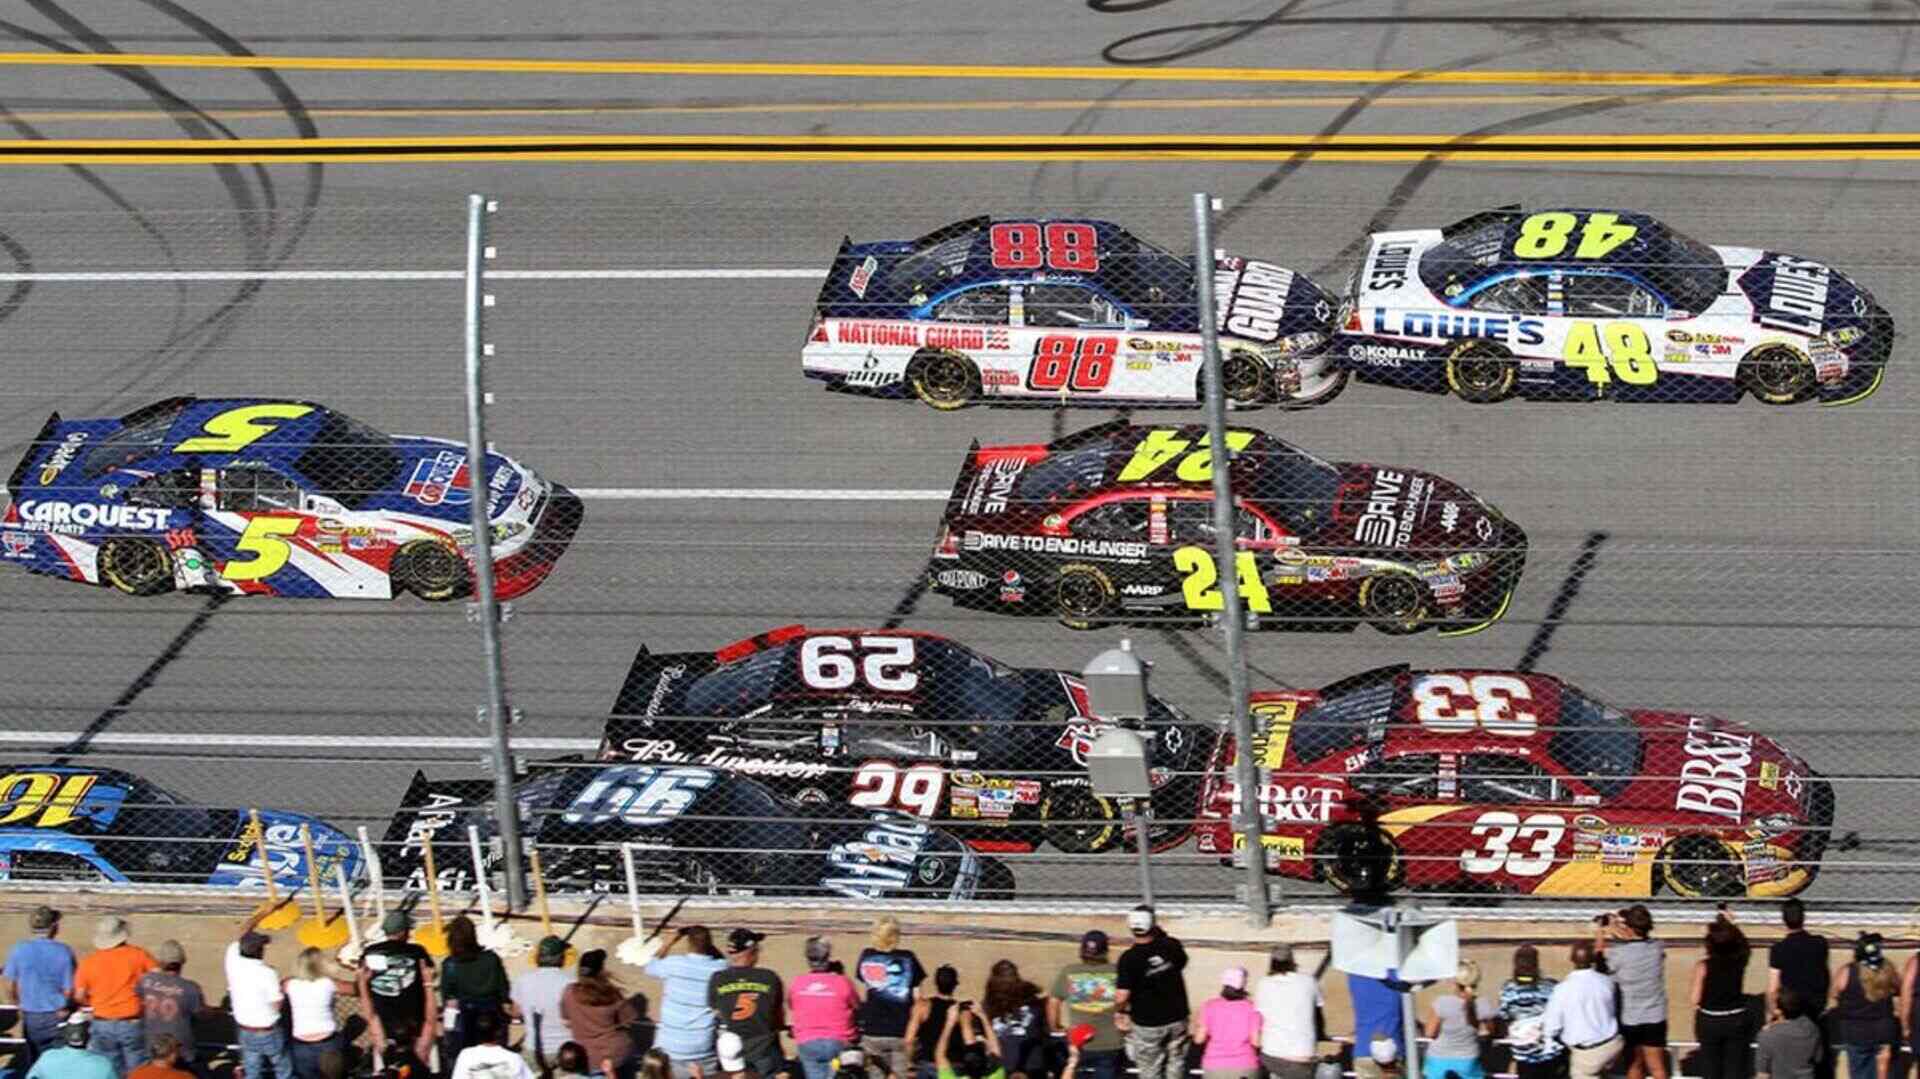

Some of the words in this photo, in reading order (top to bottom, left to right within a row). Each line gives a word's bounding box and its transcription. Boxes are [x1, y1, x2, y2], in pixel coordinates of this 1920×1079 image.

[991, 223, 1100, 272] 88
[1514, 212, 1637, 258] 48
[1227, 261, 1295, 341] GUARD
[1374, 306, 1545, 345] LOWE'S
[838, 322, 920, 347] NATIONAL
[926, 326, 984, 350] GUARD
[1025, 335, 1119, 391] 88
[1367, 345, 1426, 361] KOBALT
[1563, 320, 1660, 385] 48
[172, 404, 316, 453] 5
[1116, 430, 1255, 481] 24
[19, 501, 172, 530] CARQUEST
[1354, 469, 1405, 546] DRIVE
[220, 516, 302, 582] 5
[964, 530, 1021, 551] DRIVE
[1023, 536, 1044, 551] TO
[1046, 537, 1079, 554] END
[1081, 539, 1149, 557] HUNGER
[1173, 546, 1272, 613] 24
[801, 636, 918, 691] 29
[1413, 674, 1538, 737] 33
[848, 762, 944, 817] 29
[1676, 717, 1752, 825] BB&T
[1459, 811, 1566, 876] 33
